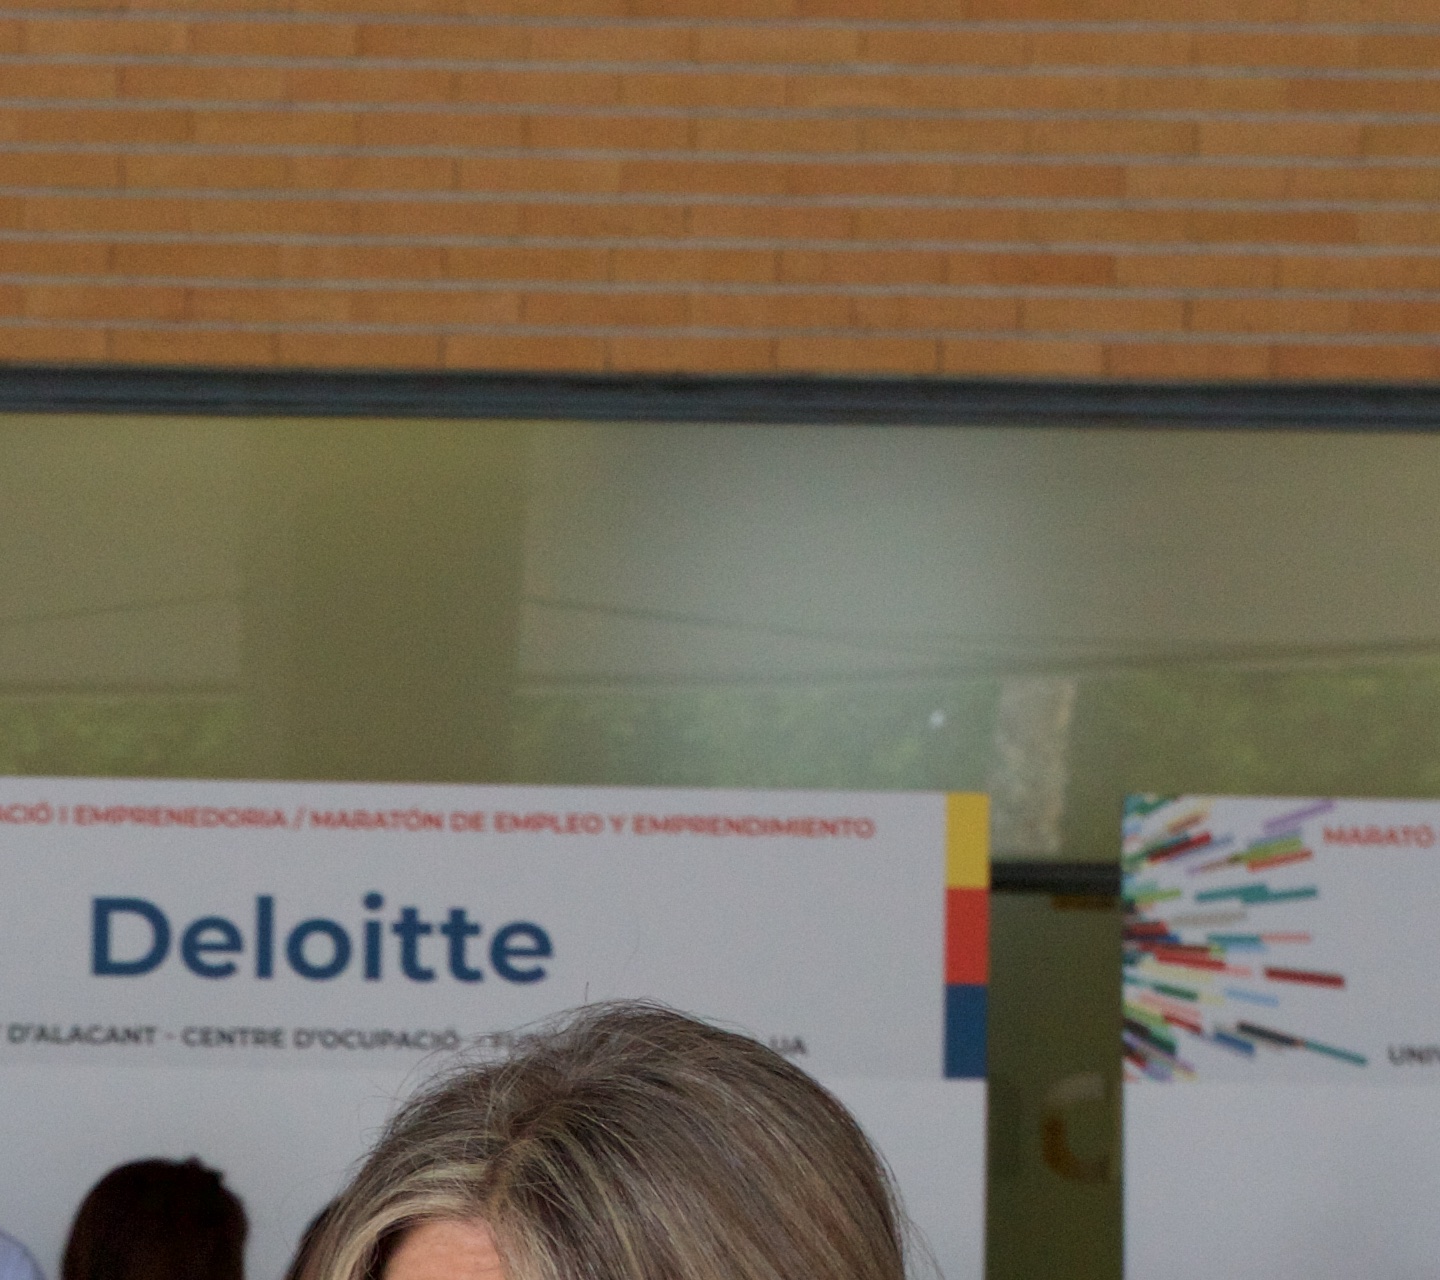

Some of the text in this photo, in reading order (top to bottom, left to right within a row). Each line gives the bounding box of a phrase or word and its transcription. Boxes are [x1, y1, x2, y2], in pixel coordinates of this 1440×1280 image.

[74, 805, 287, 829] EMPRENEDORIA
[310, 807, 443, 832] MARATÓN
[450, 811, 484, 833] DE
[494, 812, 605, 835] EMPLEO
[610, 814, 625, 834] Y
[632, 815, 876, 839] EMPRENDIMIENTO
[1323, 824, 1436, 848] MARATÓ
[91, 892, 554, 984] Deloitte
[6, 1022, 158, 1047] D'ALACANT
[180, 1025, 286, 1049] CENTRE
[292, 1026, 461, 1053] D'OCUPACIÓ
